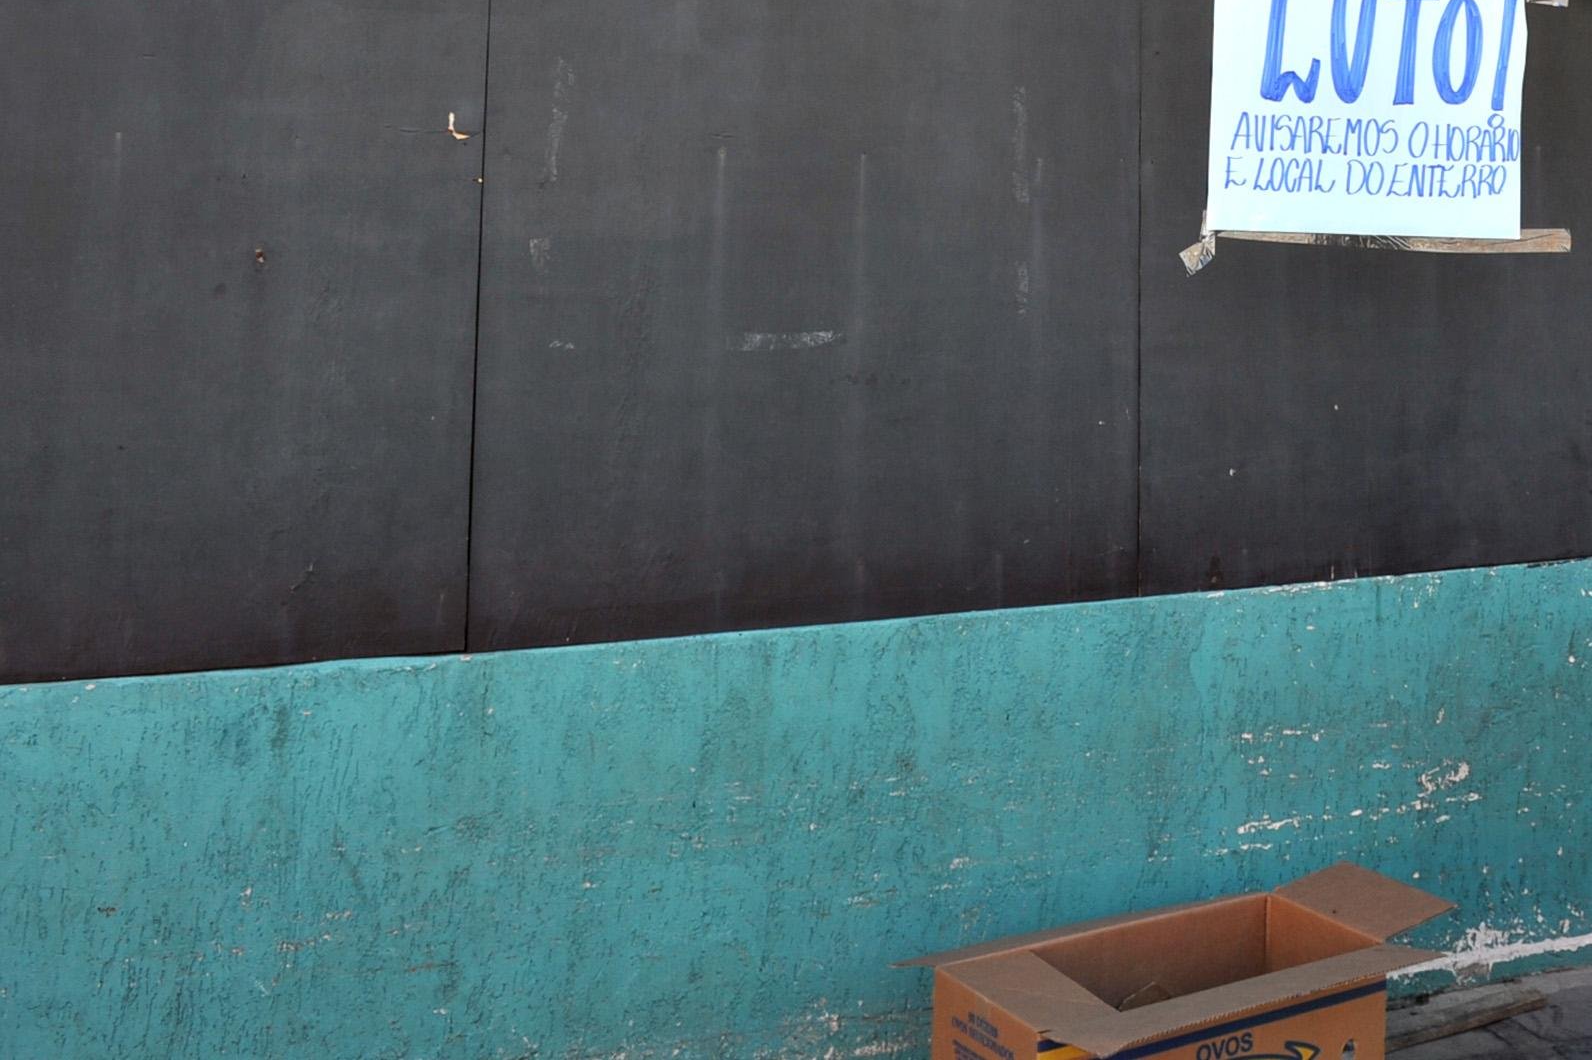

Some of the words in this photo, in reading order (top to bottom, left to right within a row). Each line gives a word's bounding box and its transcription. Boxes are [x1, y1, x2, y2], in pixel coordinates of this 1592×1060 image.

[1230, 111, 1399, 157] AVISAREMOS
[1224, 156, 1248, 189] E
[1253, 157, 1336, 193] LOCAL
[1346, 158, 1385, 195] DO
[1386, 162, 1508, 199] ENTERRO
[1195, 1031, 1254, 1060] OVOS
